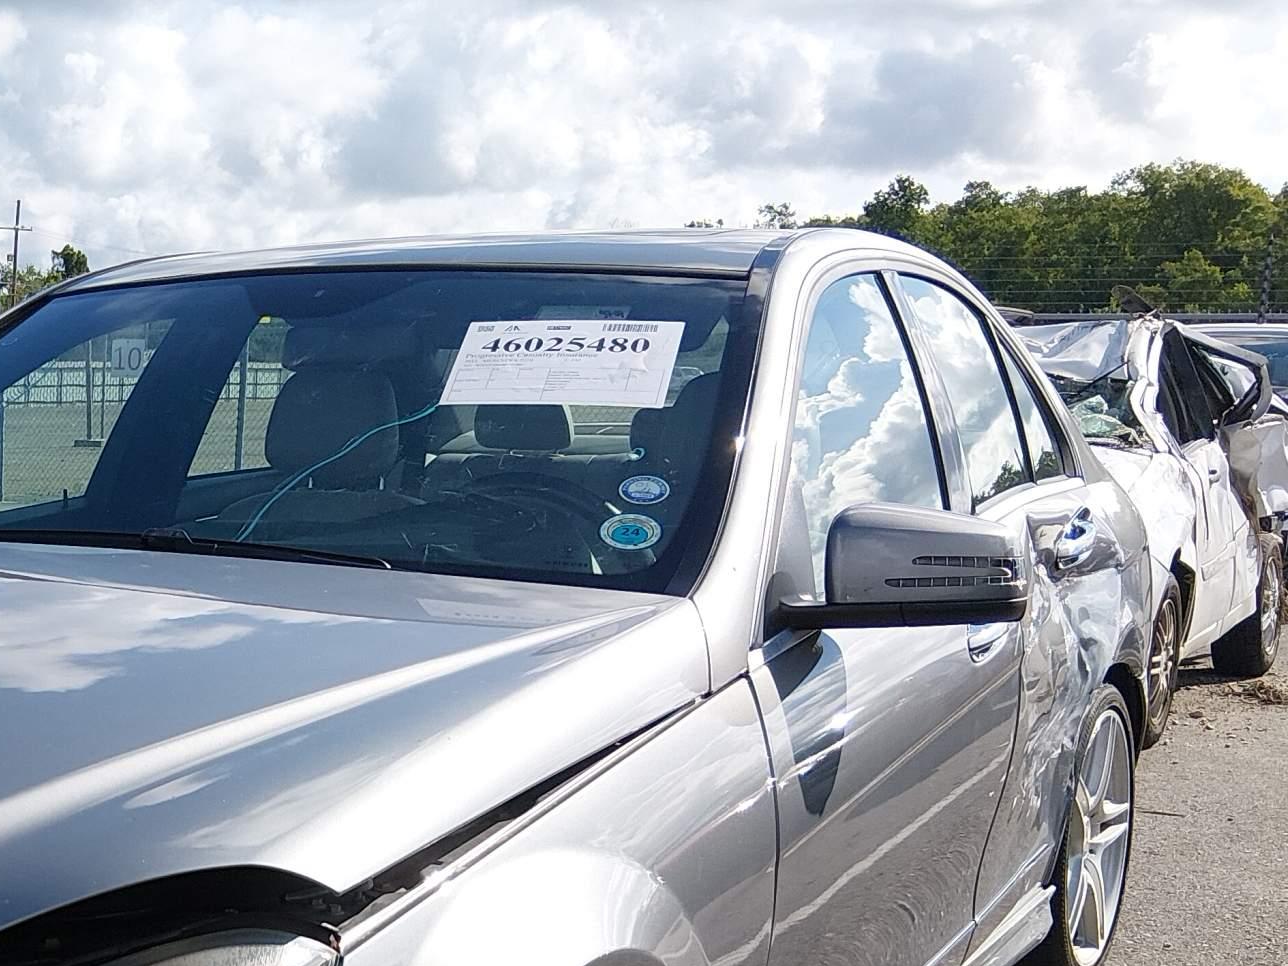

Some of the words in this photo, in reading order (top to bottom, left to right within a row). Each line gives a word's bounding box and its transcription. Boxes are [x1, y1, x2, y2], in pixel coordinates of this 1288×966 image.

[481, 337, 650, 353] 46025480
[114, 346, 142, 371] 10
[621, 527, 641, 537] 24
